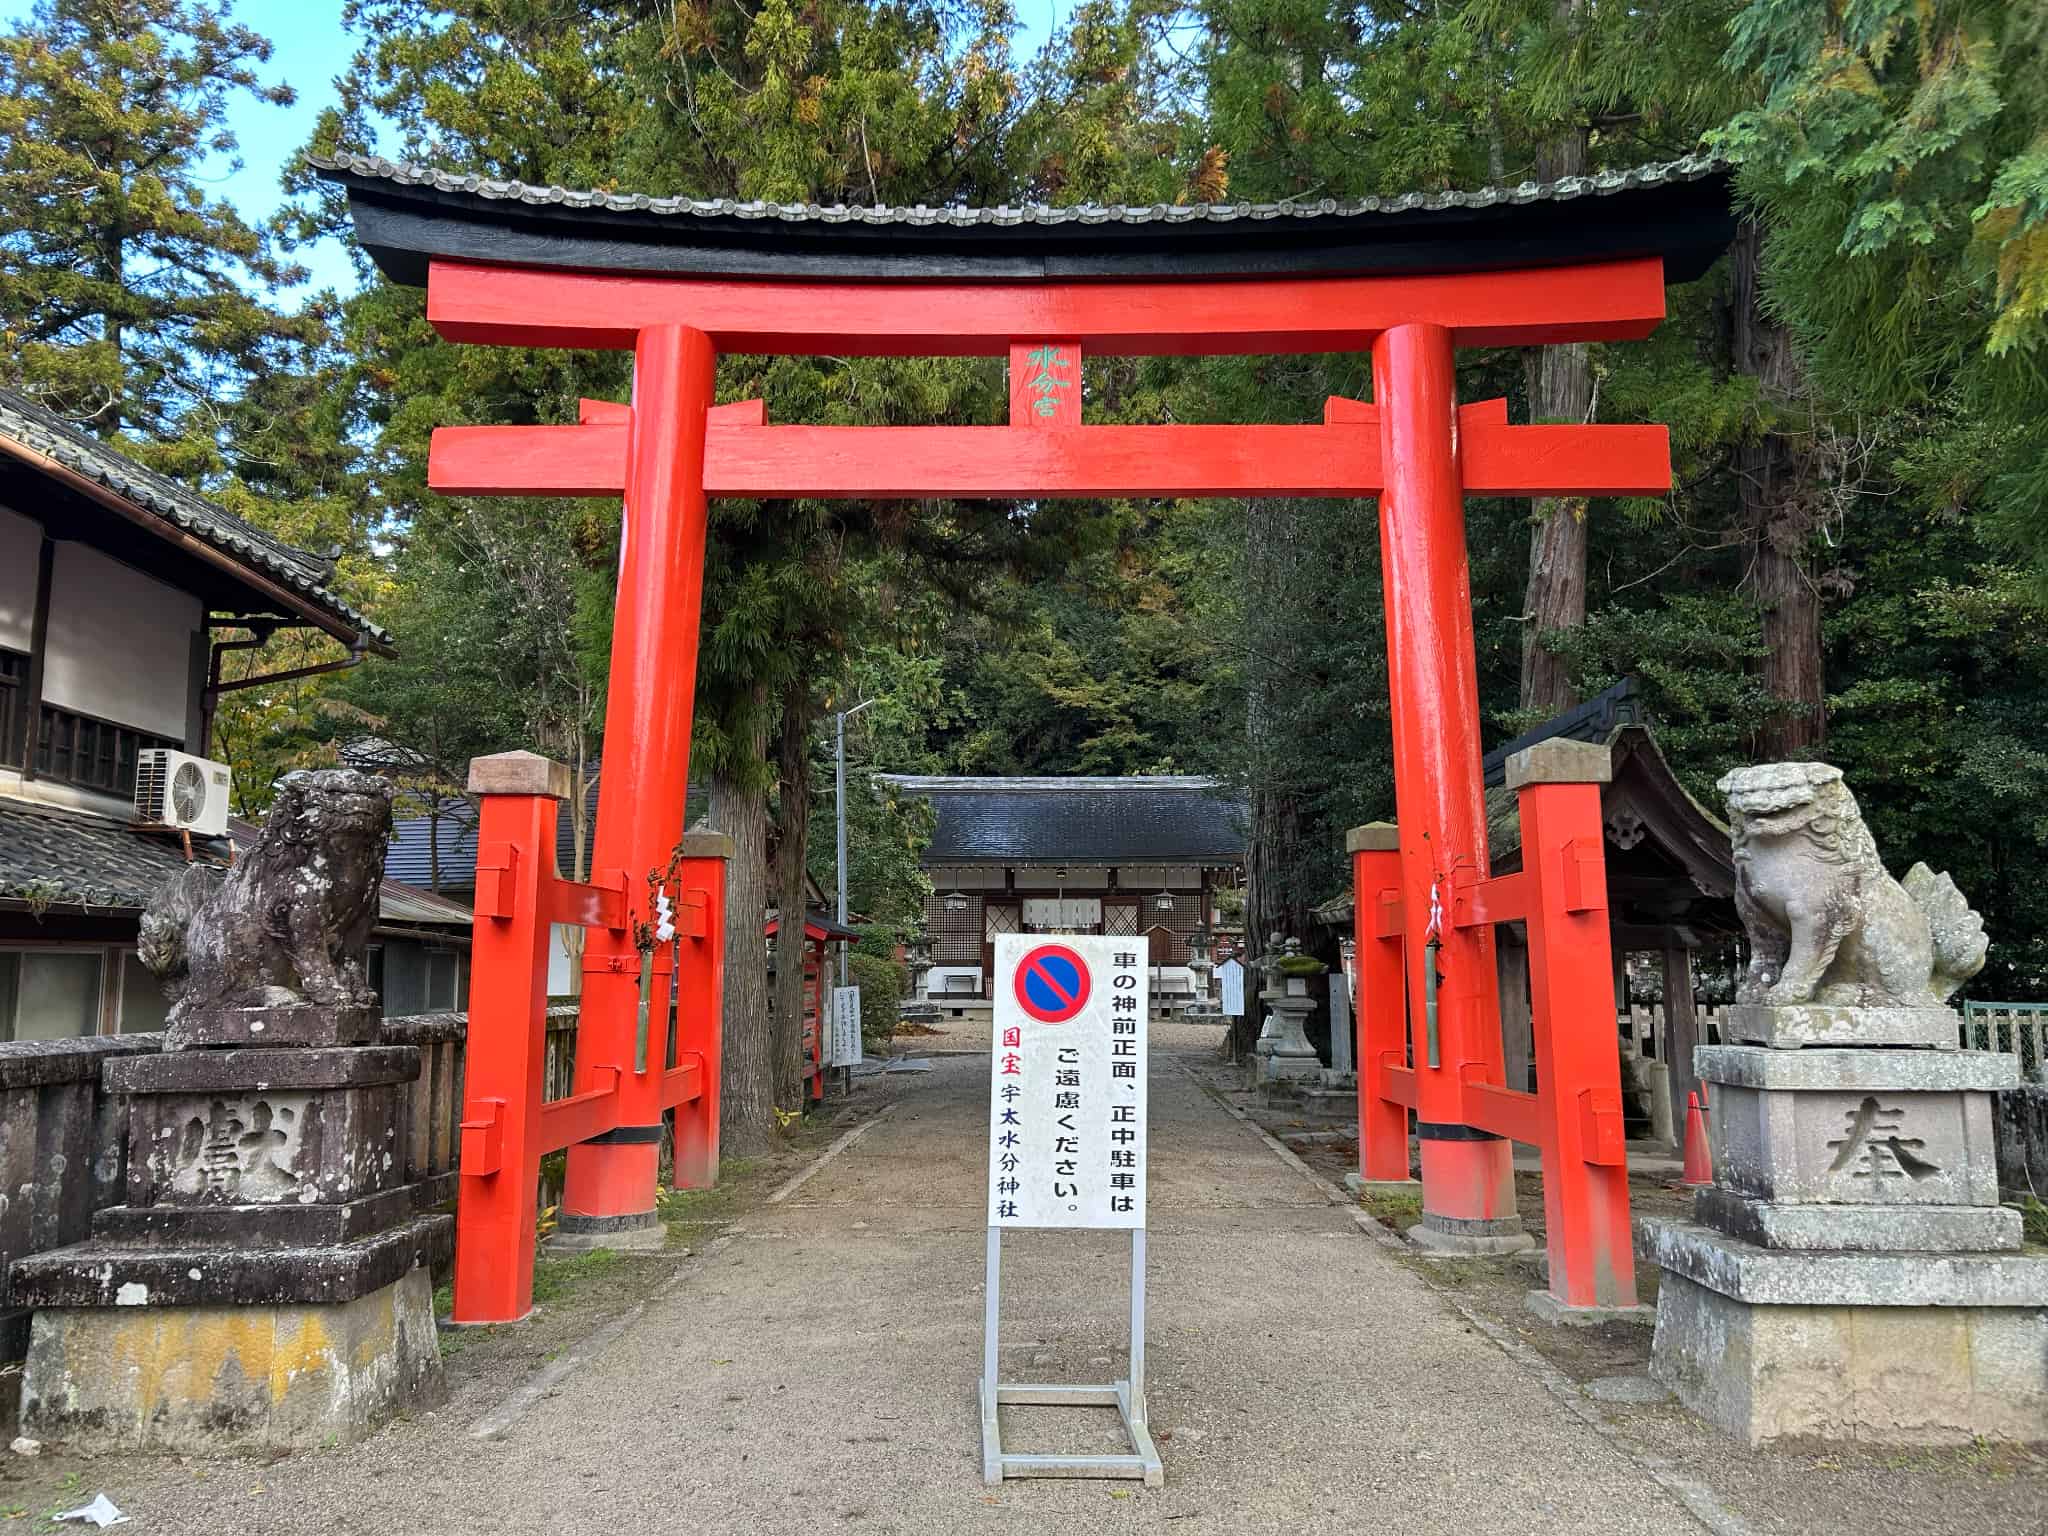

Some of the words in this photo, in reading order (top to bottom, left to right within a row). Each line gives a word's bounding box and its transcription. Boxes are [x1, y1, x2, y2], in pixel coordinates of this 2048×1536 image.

[1053, 1047, 1081, 1214] ご遠慮ください。
[1109, 951, 1137, 1213] 車の神前正面、正中駐車は
[1827, 1096, 1941, 1193] 奉
